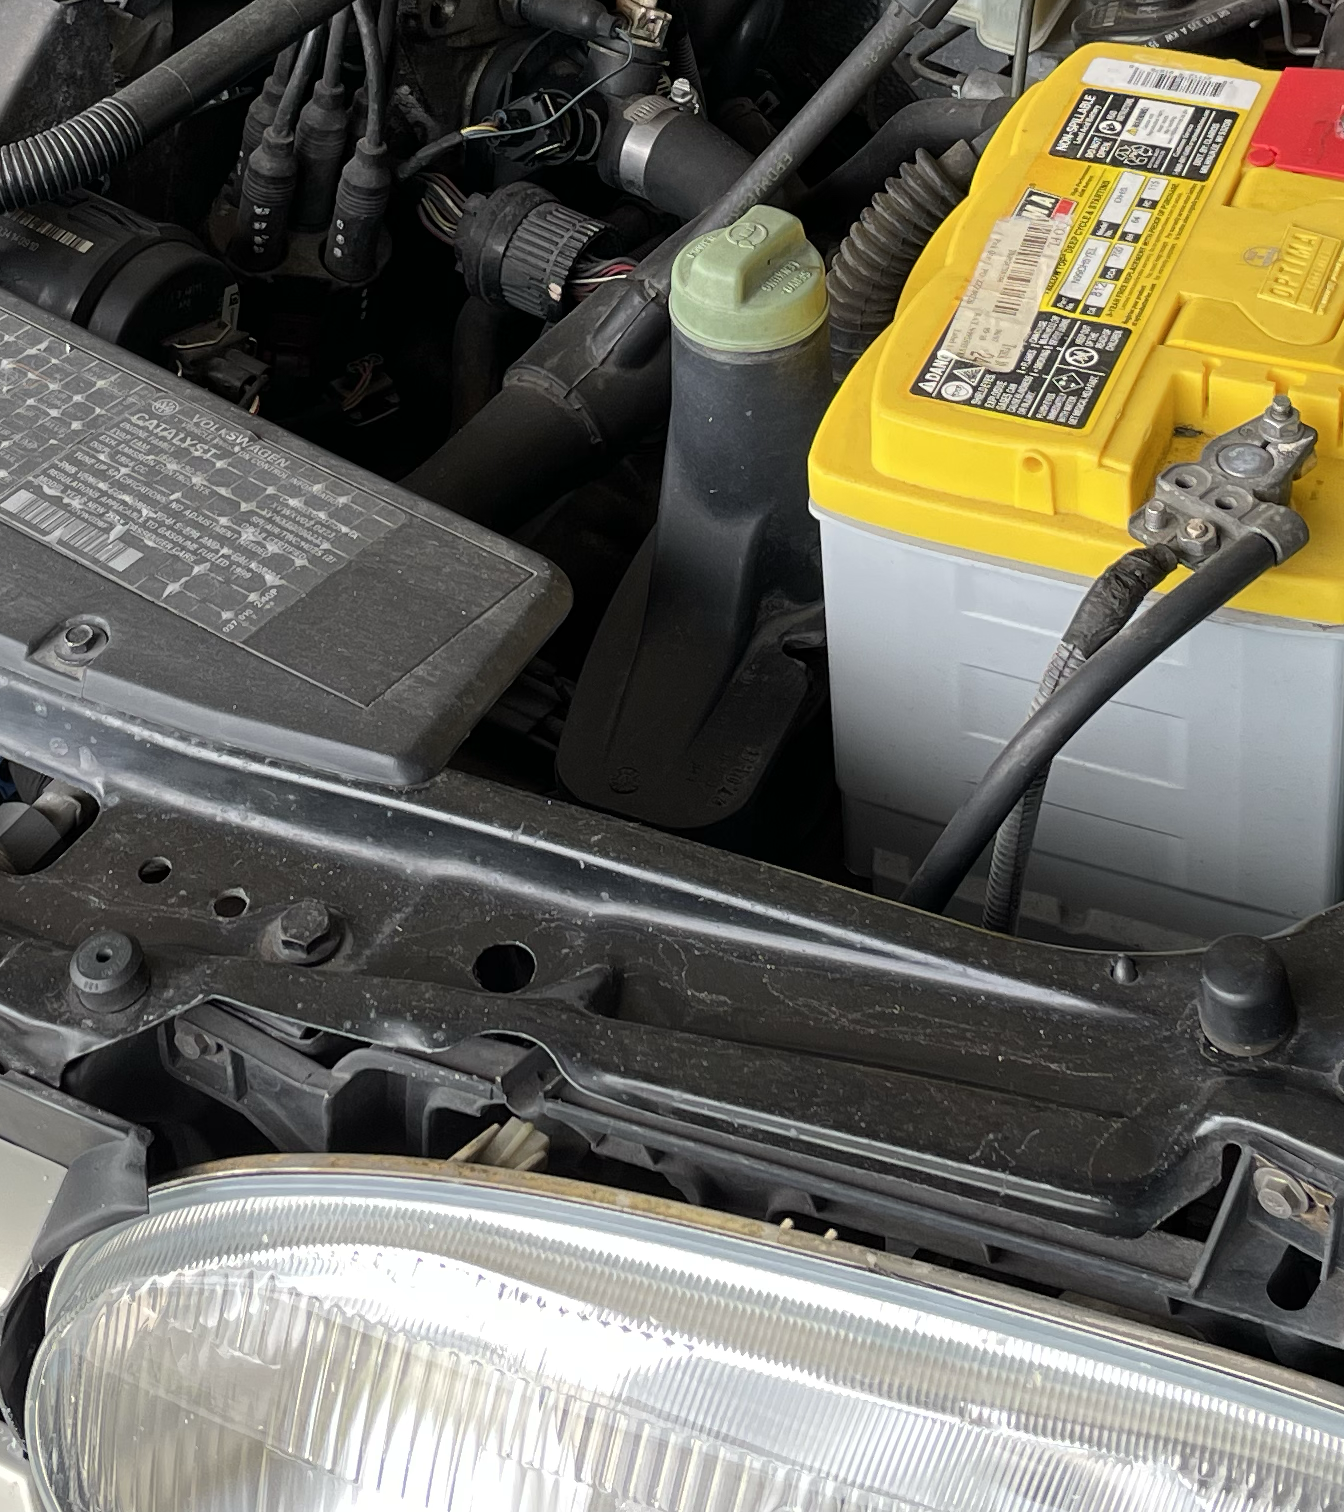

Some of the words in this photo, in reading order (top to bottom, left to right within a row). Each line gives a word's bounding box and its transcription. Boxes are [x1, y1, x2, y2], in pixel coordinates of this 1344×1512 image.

[1054, 93, 1097, 151] NON-SPILLABLE
[1269, 230, 1316, 299] OPTIMA
[126, 411, 224, 461] CATALYST
[185, 413, 296, 468] VOLKSWAGEN
[44, 467, 102, 499] REGULATIONS
[96, 495, 149, 523] APPLICABLE
[144, 519, 161, 530] TO
[154, 525, 201, 551] GASOLINE
[194, 546, 233, 568] FUELED
[83, 499, 109, 514] NEW
[179, 508, 241, 541] ADJUSTMENT
